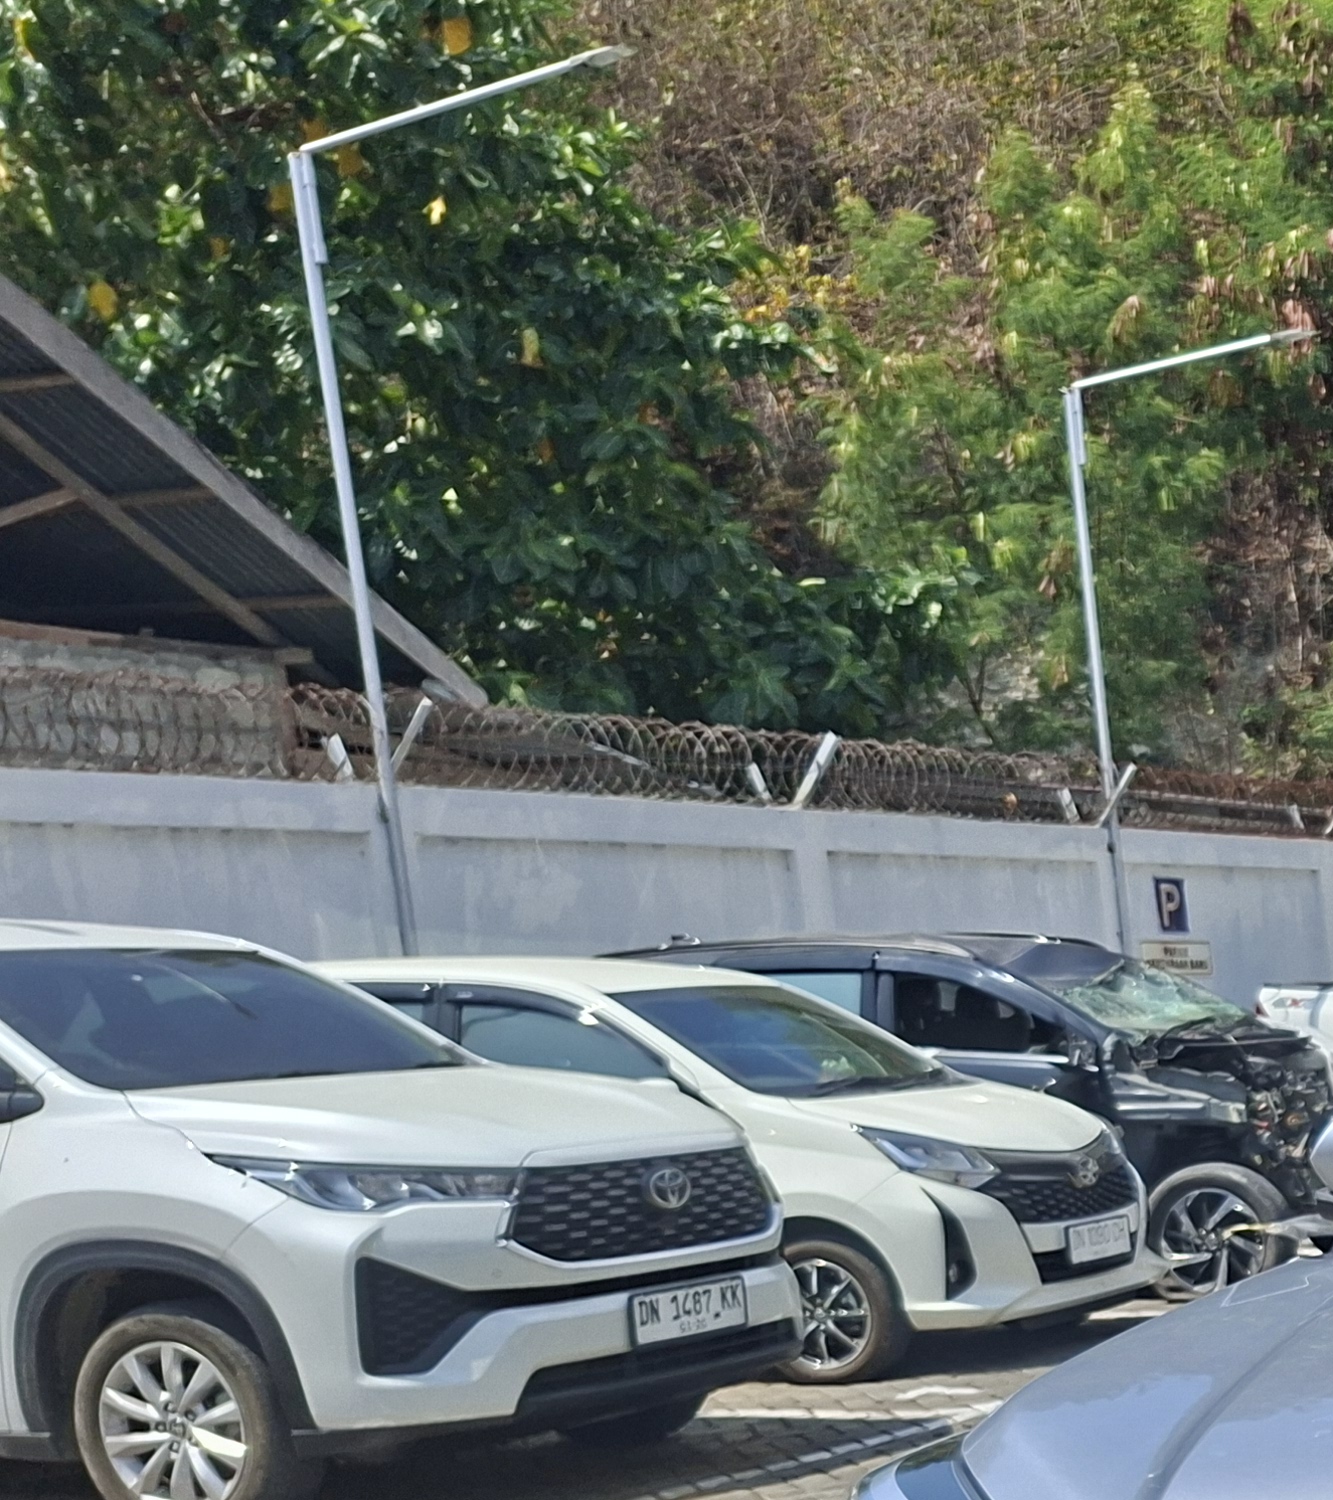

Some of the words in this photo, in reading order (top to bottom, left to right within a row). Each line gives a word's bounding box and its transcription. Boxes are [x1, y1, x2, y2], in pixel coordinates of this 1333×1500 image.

[1159, 883, 1181, 928] P
[638, 1298, 661, 1327] DN
[719, 1283, 742, 1311] KK
